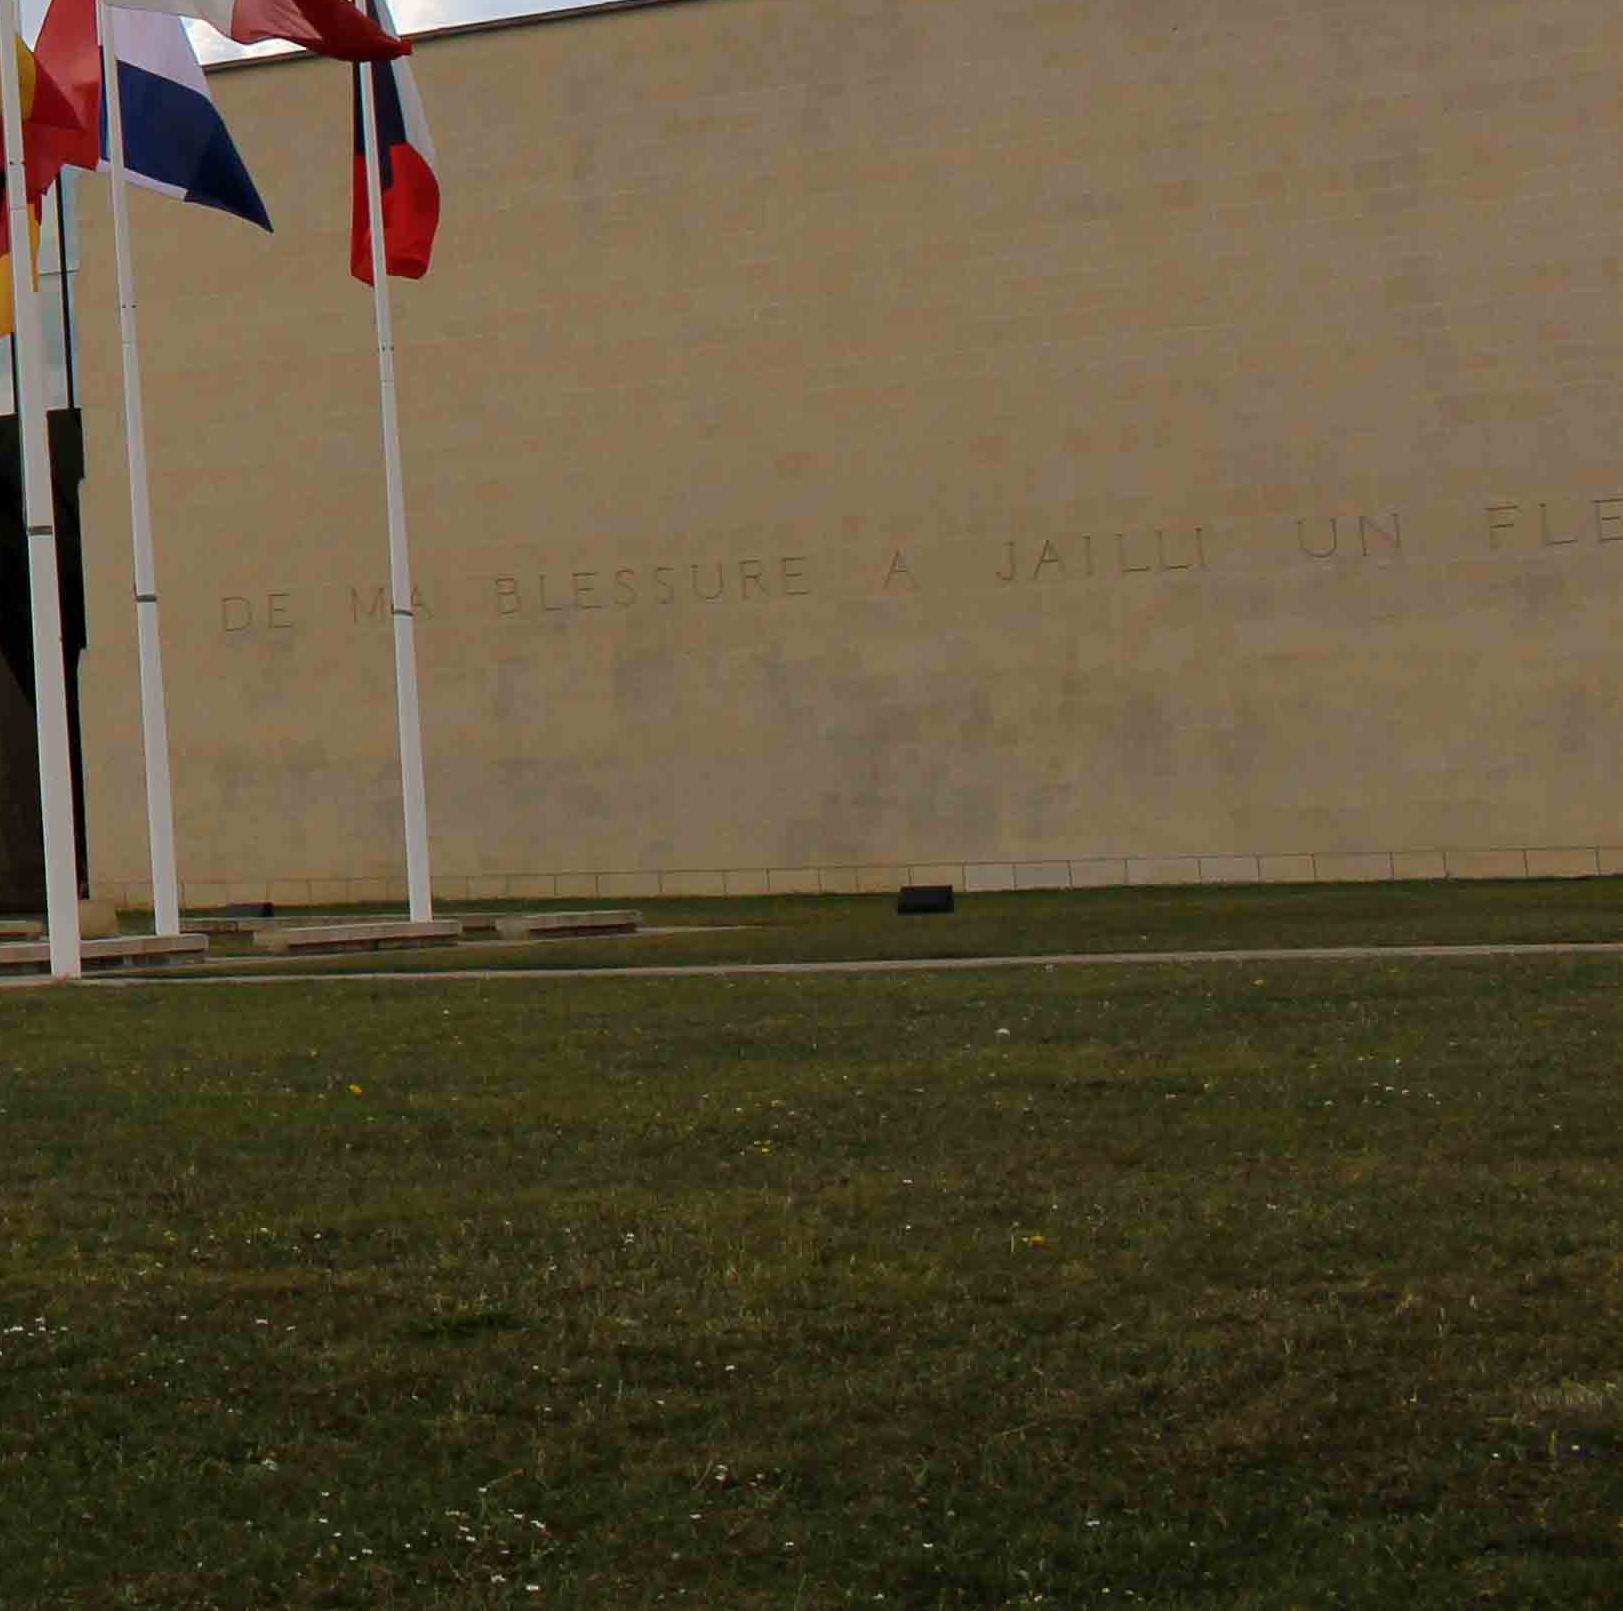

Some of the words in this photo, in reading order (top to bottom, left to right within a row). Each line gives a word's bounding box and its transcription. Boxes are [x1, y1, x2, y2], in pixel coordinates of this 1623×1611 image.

[220, 589, 293, 632] DE
[349, 584, 434, 624] MA
[494, 556, 810, 617] BLESSURE
[882, 548, 921, 589] A
[994, 526, 1209, 581] JAILLI
[1296, 511, 1402, 558] UN
